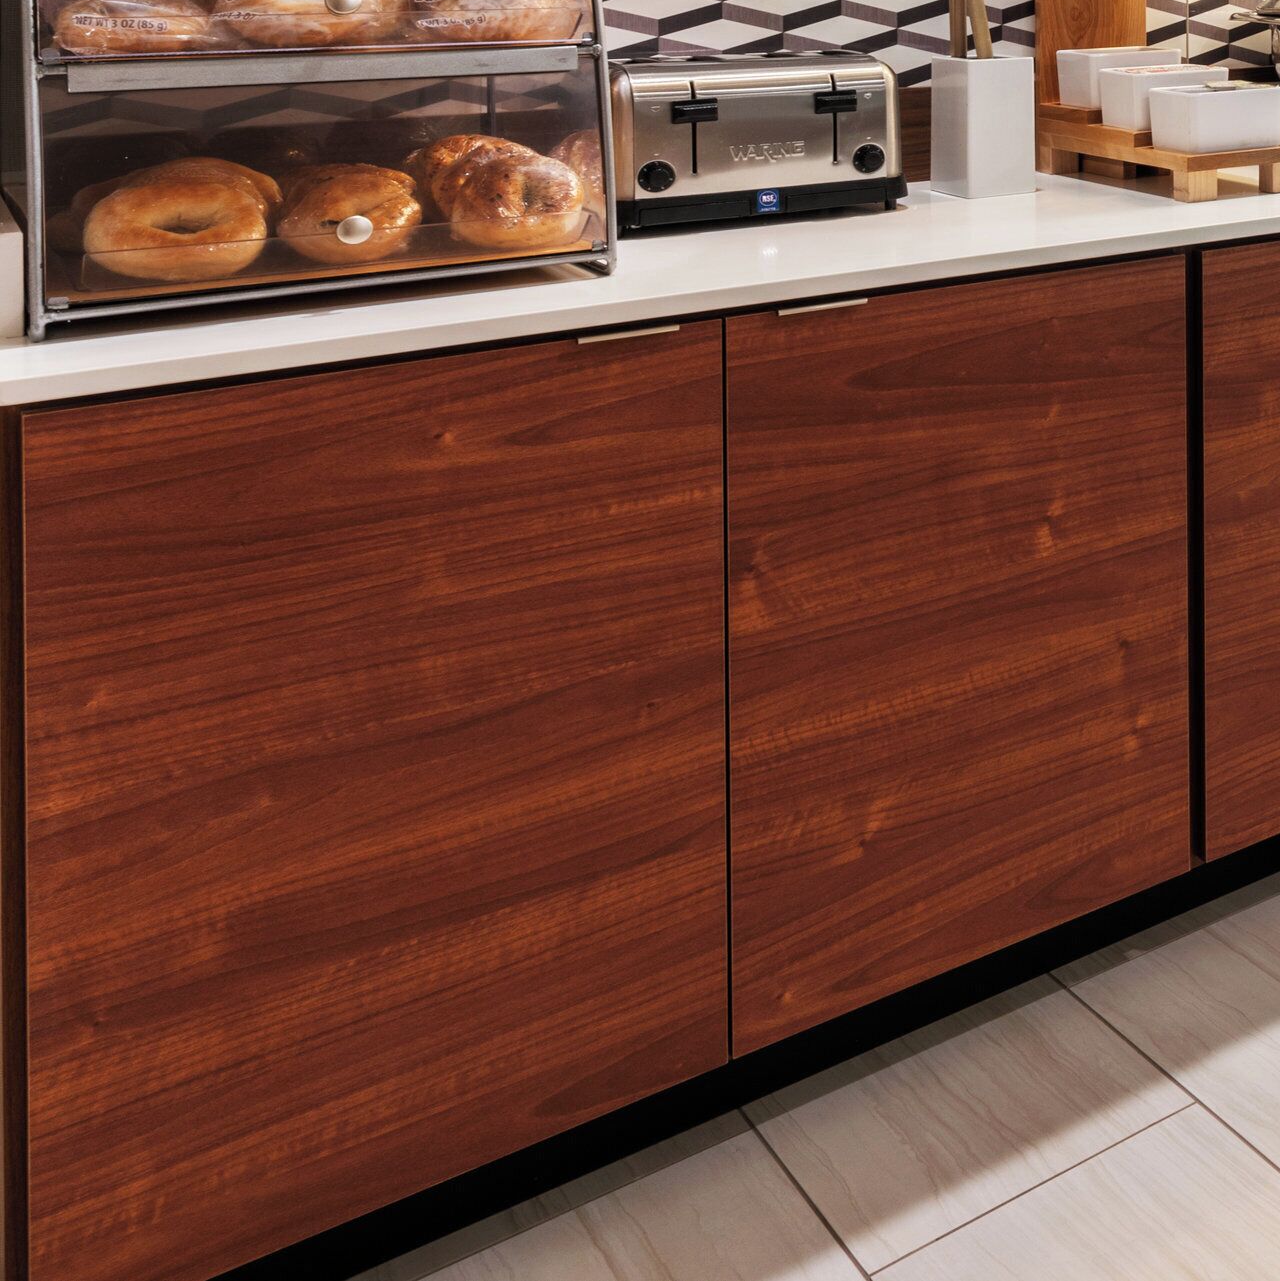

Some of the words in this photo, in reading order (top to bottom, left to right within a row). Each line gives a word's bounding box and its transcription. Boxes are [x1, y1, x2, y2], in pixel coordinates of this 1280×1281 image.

[74, 16, 92, 25] NET
[111, 19, 118, 28] 3
[120, 19, 135, 30] OZ
[137, 20, 154, 31] (85
[157, 20, 168, 32] g)
[728, 140, 805, 163] WARING
